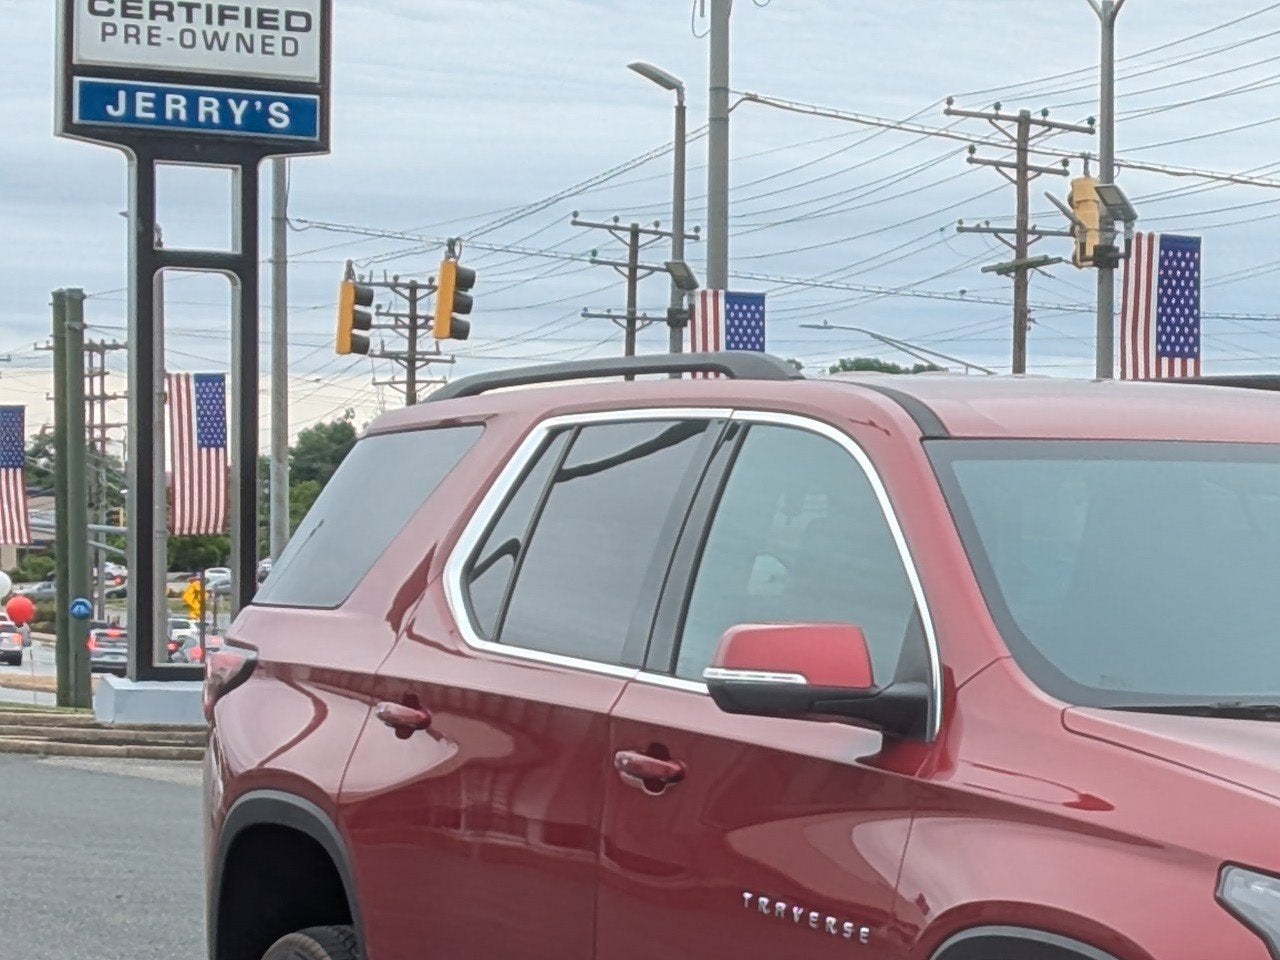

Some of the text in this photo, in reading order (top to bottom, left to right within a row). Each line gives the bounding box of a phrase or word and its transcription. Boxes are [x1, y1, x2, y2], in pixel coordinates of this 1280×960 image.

[88, 0, 312, 32] CERTIFIED
[101, 22, 299, 57] PRE-OWNED
[105, 90, 291, 128] JERRY'S
[742, 891, 871, 945] TRAVERSE
